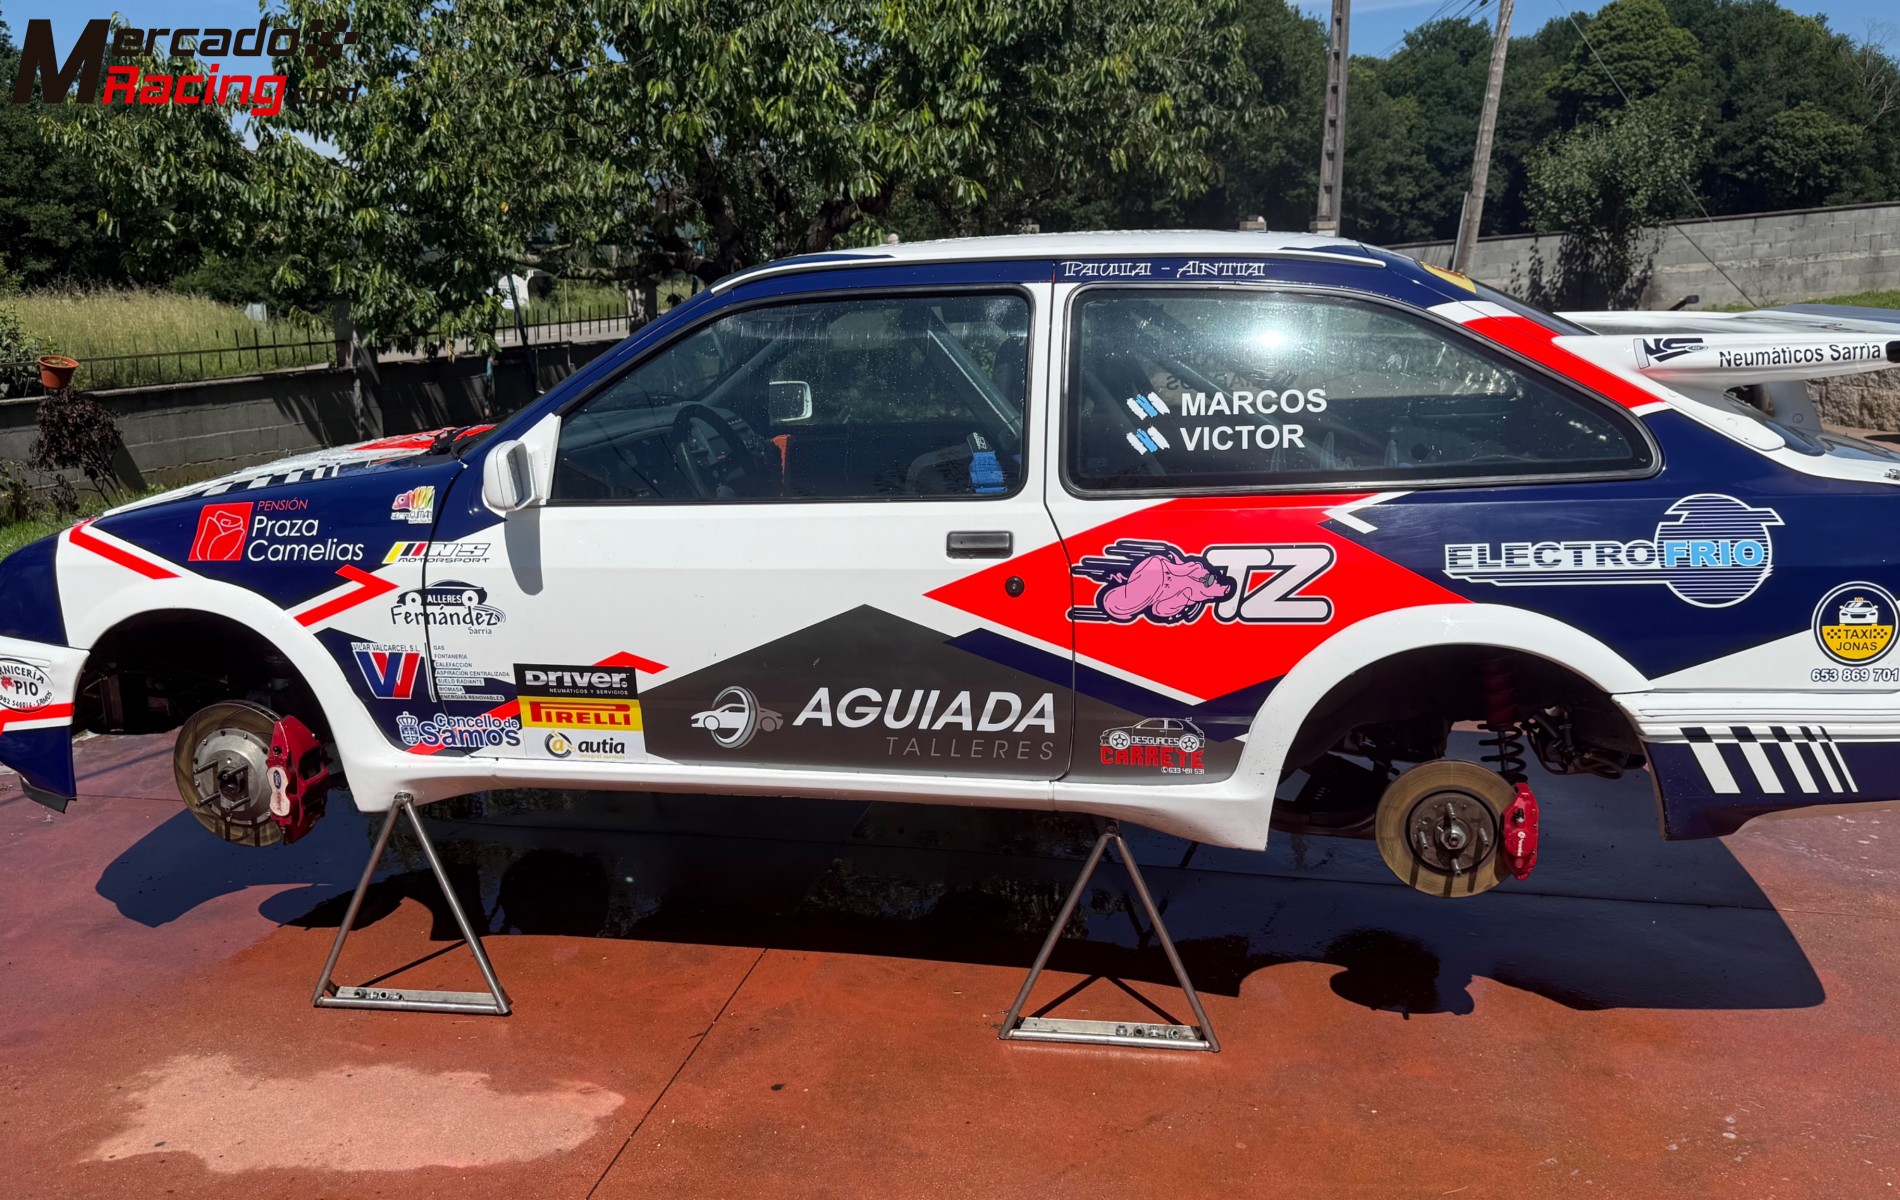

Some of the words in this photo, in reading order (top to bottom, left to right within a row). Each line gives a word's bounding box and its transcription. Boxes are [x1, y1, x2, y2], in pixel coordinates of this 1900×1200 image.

[1719, 346, 1824, 369] Neumáticos
[1180, 388, 1328, 417] MARCOS
[1179, 424, 1306, 452] VICTOR
[257, 497, 309, 512] PENSIÓN
[252, 515, 319, 537] Praza
[247, 538, 365, 562] Camelias
[1202, 544, 1335, 623] TZ
[425, 594, 462, 604] ALLERES
[390, 603, 499, 626] Fernández
[468, 626, 492, 635] Sarria
[1843, 629, 1872, 640] TAXI
[372, 643, 408, 652] VALCARCEL
[1836, 641, 1878, 651] JONAS
[1811, 668, 1839, 682] 653
[1842, 668, 1870, 682] 869
[1873, 667, 1899, 682] 701
[435, 713, 502, 728] Concello
[503, 718, 519, 729] de
[529, 701, 631, 726] PIRELLI
[792, 686, 1056, 734] AGUIADA
[420, 722, 521, 747] Samos
[577, 737, 625, 754] autia
[1131, 735, 1180, 746] DESGUACES
[886, 736, 1055, 761] TALLERES
[1100, 745, 1205, 770] CARRETE
